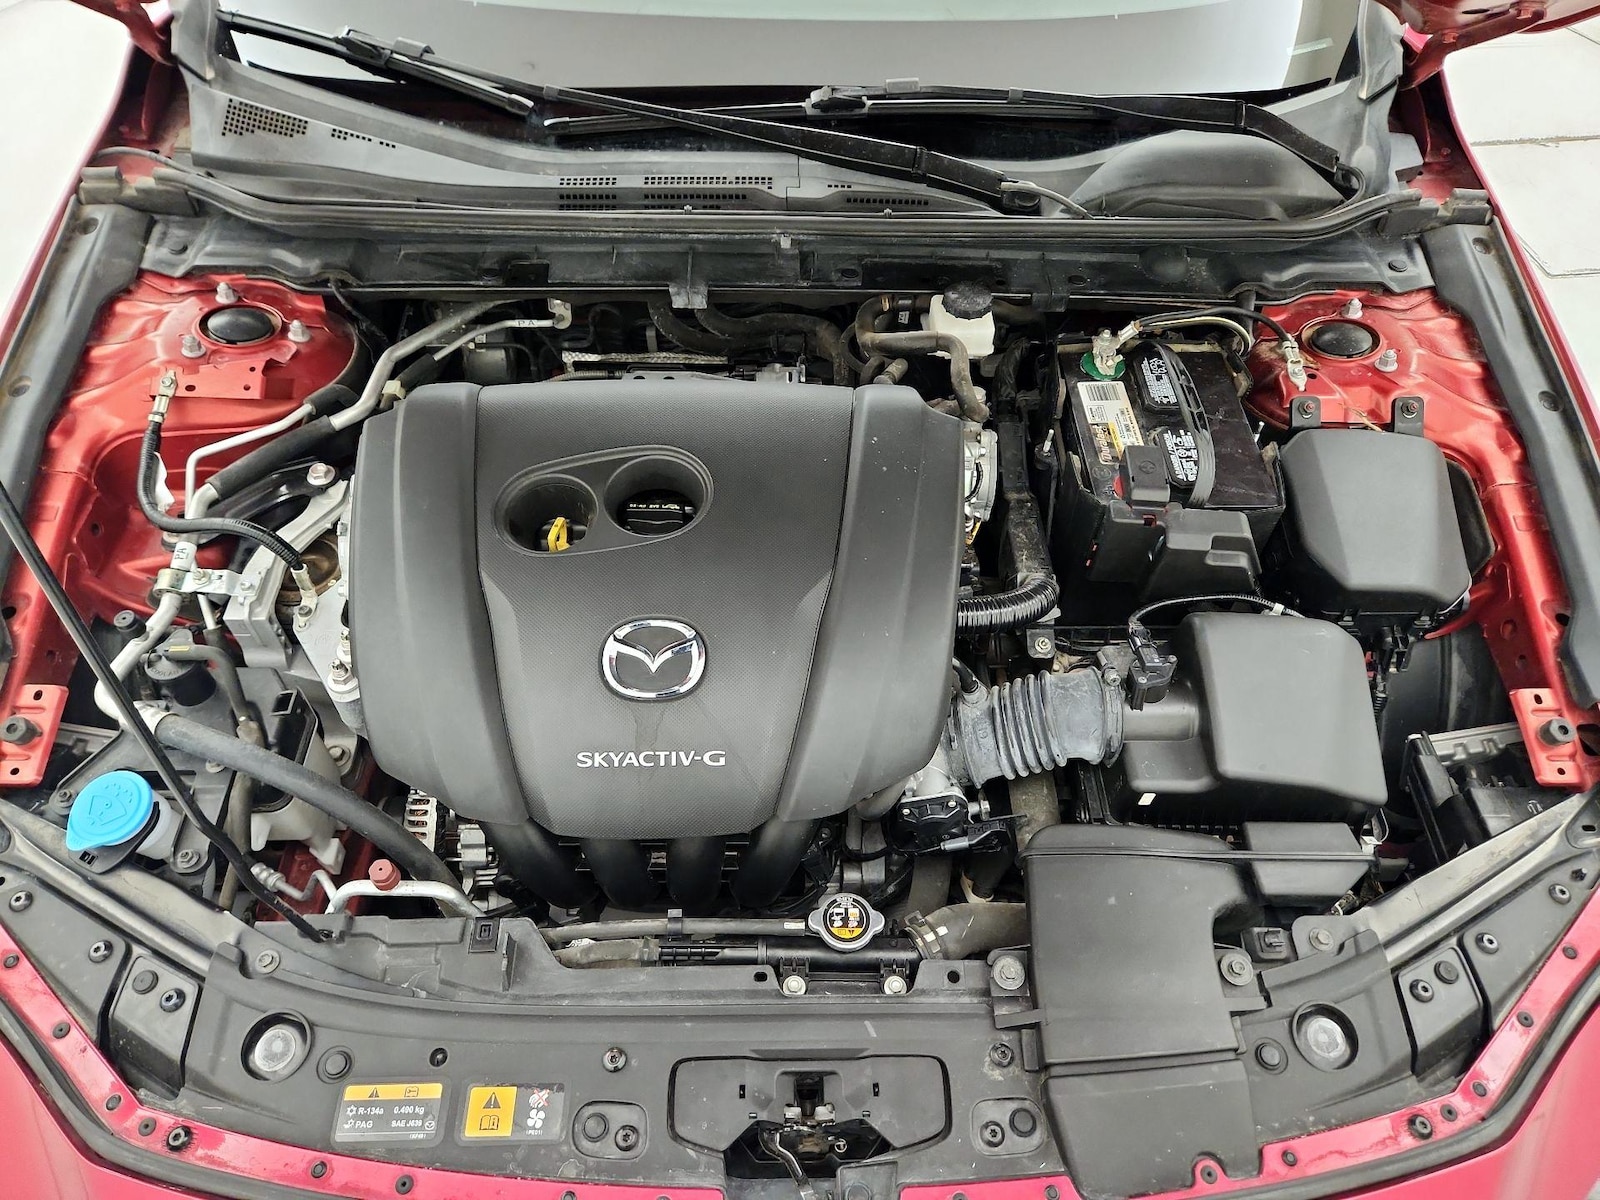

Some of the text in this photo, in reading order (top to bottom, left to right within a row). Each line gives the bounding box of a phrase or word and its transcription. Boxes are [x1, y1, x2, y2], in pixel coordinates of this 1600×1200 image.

[1092, 424, 1113, 462] Duralast
[576, 750, 726, 768] SKYACTIV-G
[358, 1104, 425, 1115] R-134a 0.490 kg
[355, 1119, 422, 1129] PAG SAE J639
